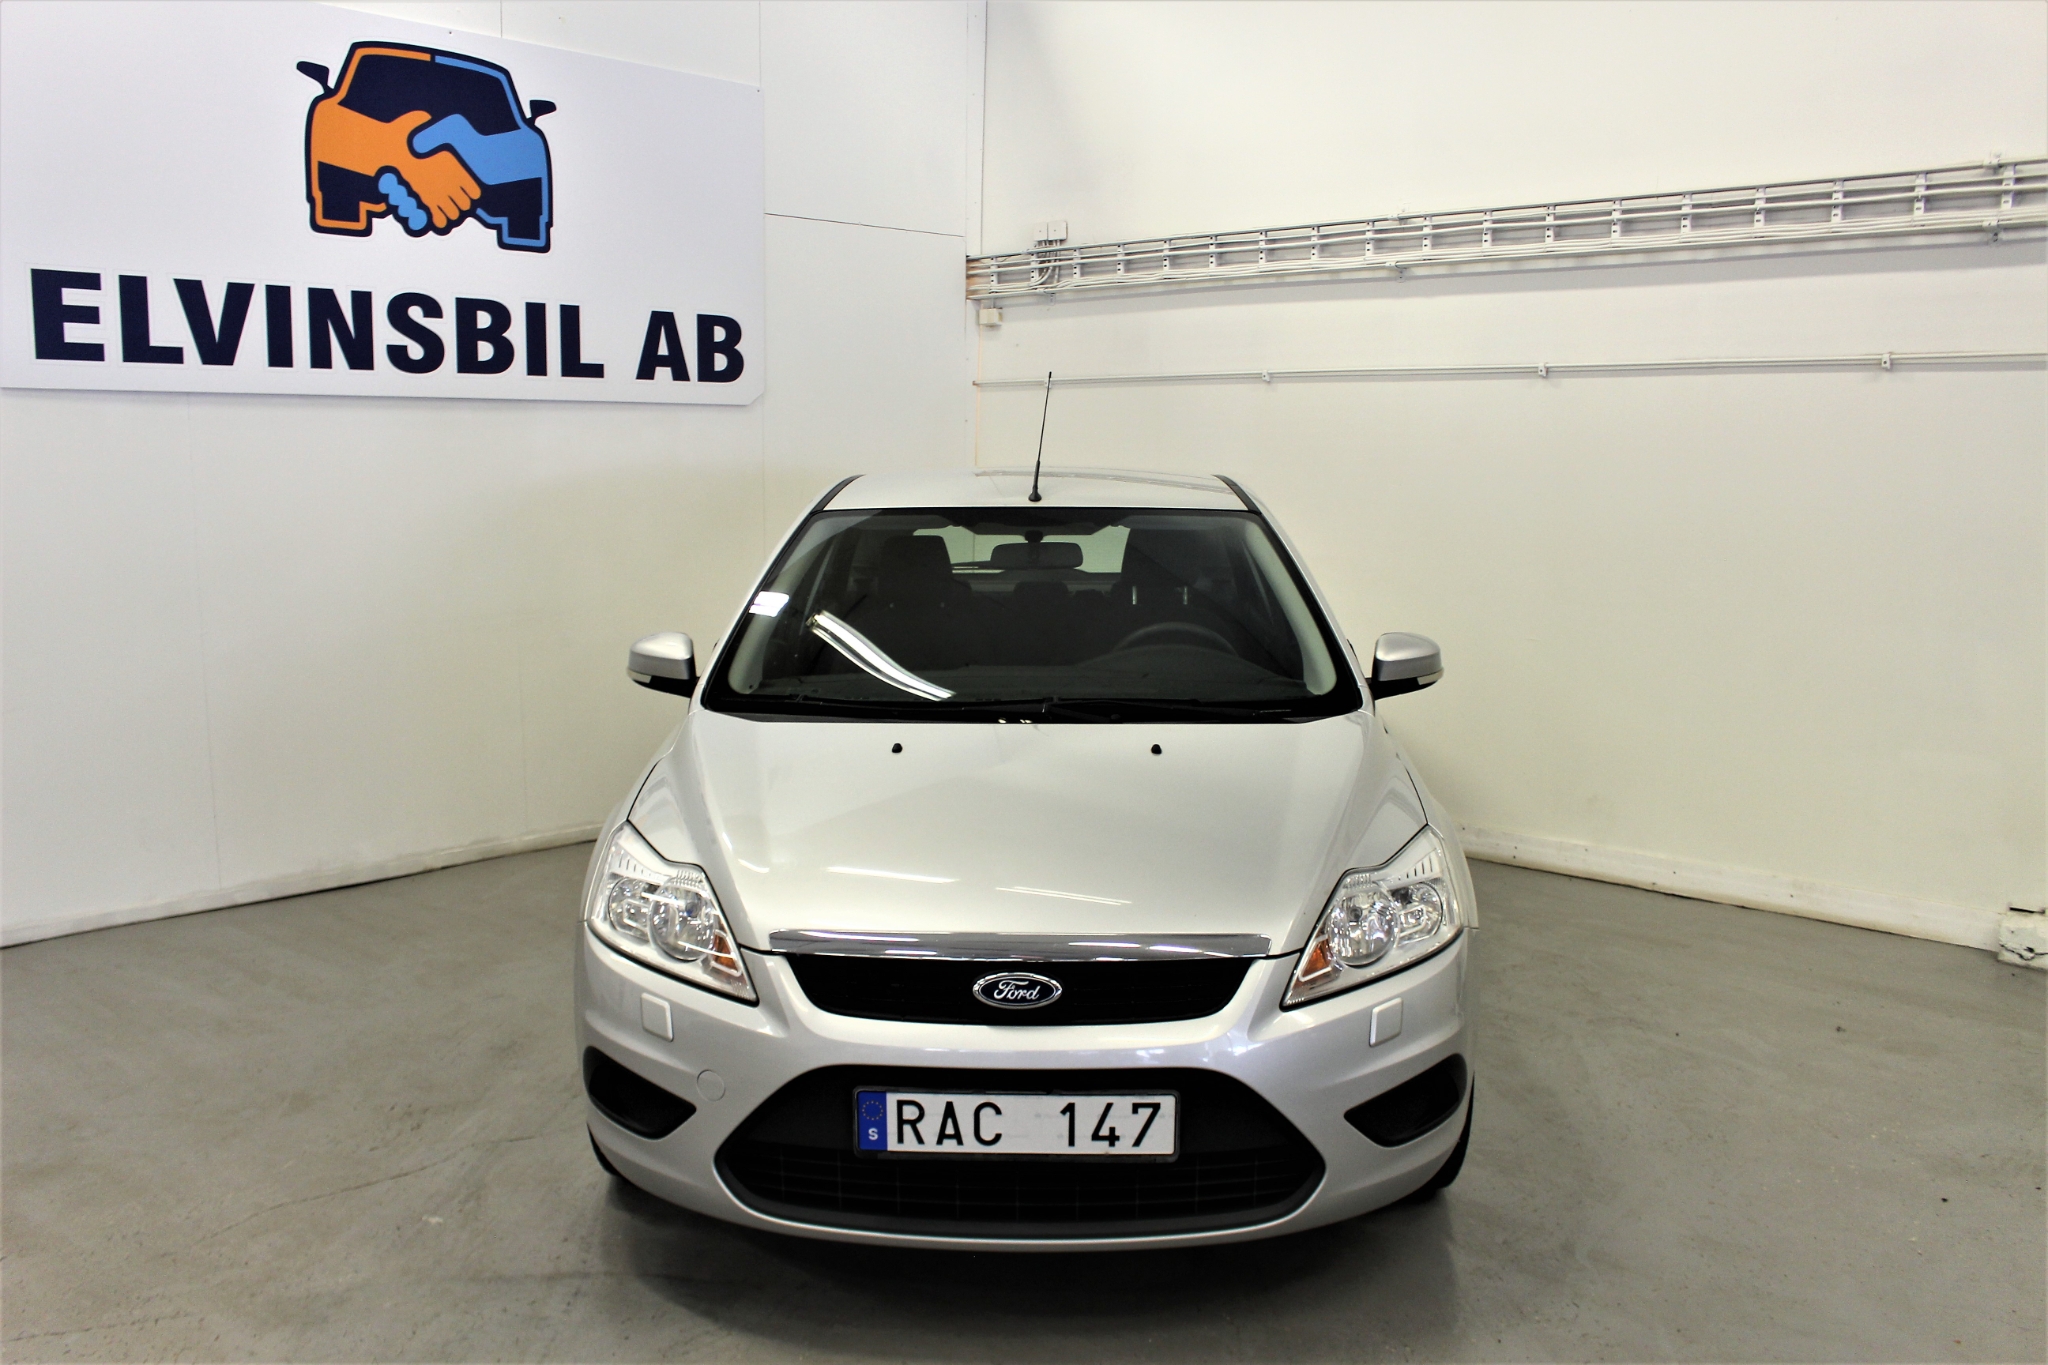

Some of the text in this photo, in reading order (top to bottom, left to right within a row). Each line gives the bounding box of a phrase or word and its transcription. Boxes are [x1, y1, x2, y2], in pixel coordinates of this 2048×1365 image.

[30, 268, 745, 383] ELVINSBIL AB
[993, 979, 1041, 1001] Ford
[868, 1127, 879, 1141] S
[896, 1099, 1162, 1148] RAC 147
